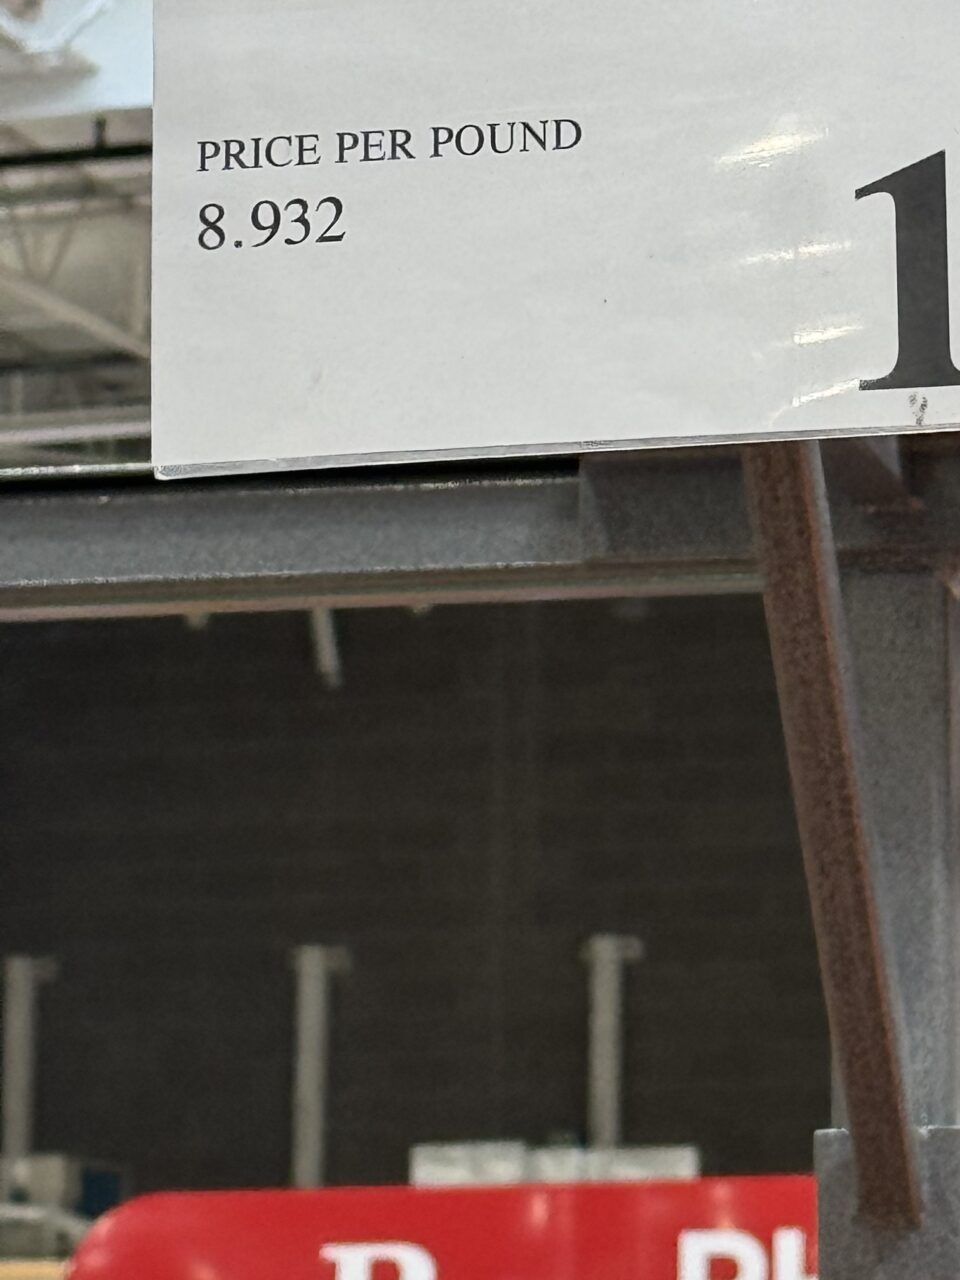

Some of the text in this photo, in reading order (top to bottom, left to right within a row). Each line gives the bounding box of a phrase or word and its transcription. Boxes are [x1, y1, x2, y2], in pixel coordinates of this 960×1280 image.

[196, 119, 582, 172] PRICE PER POUND
[198, 196, 346, 251] 8.932
